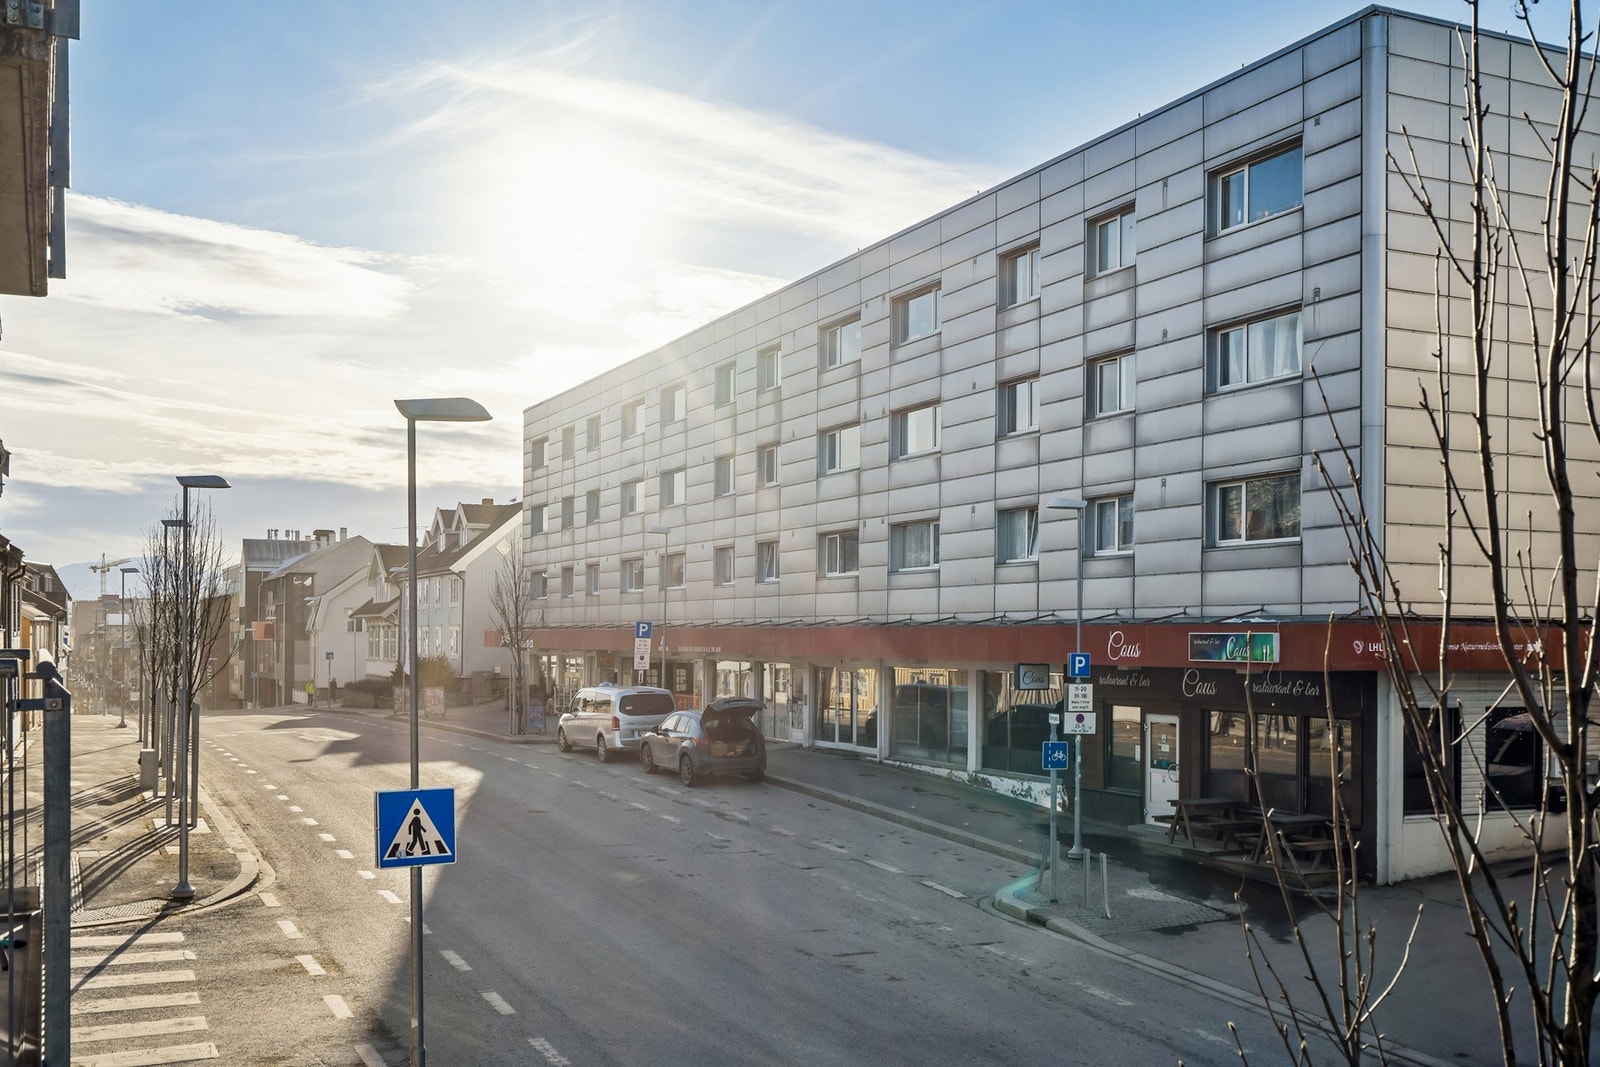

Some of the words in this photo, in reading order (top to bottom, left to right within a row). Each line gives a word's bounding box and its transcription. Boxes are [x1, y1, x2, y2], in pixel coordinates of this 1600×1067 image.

[639, 623, 649, 636] P
[1107, 630, 1142, 660] Cous
[1226, 636, 1250, 659] Cous
[1075, 656, 1086, 674] P
[1022, 669, 1045, 685] Cous
[1130, 673, 1138, 687] &
[1182, 667, 1218, 697] Cous
[1252, 680, 1292, 694] restaurant
[1292, 680, 1304, 696] &
[1304, 682, 1320, 696] bar
